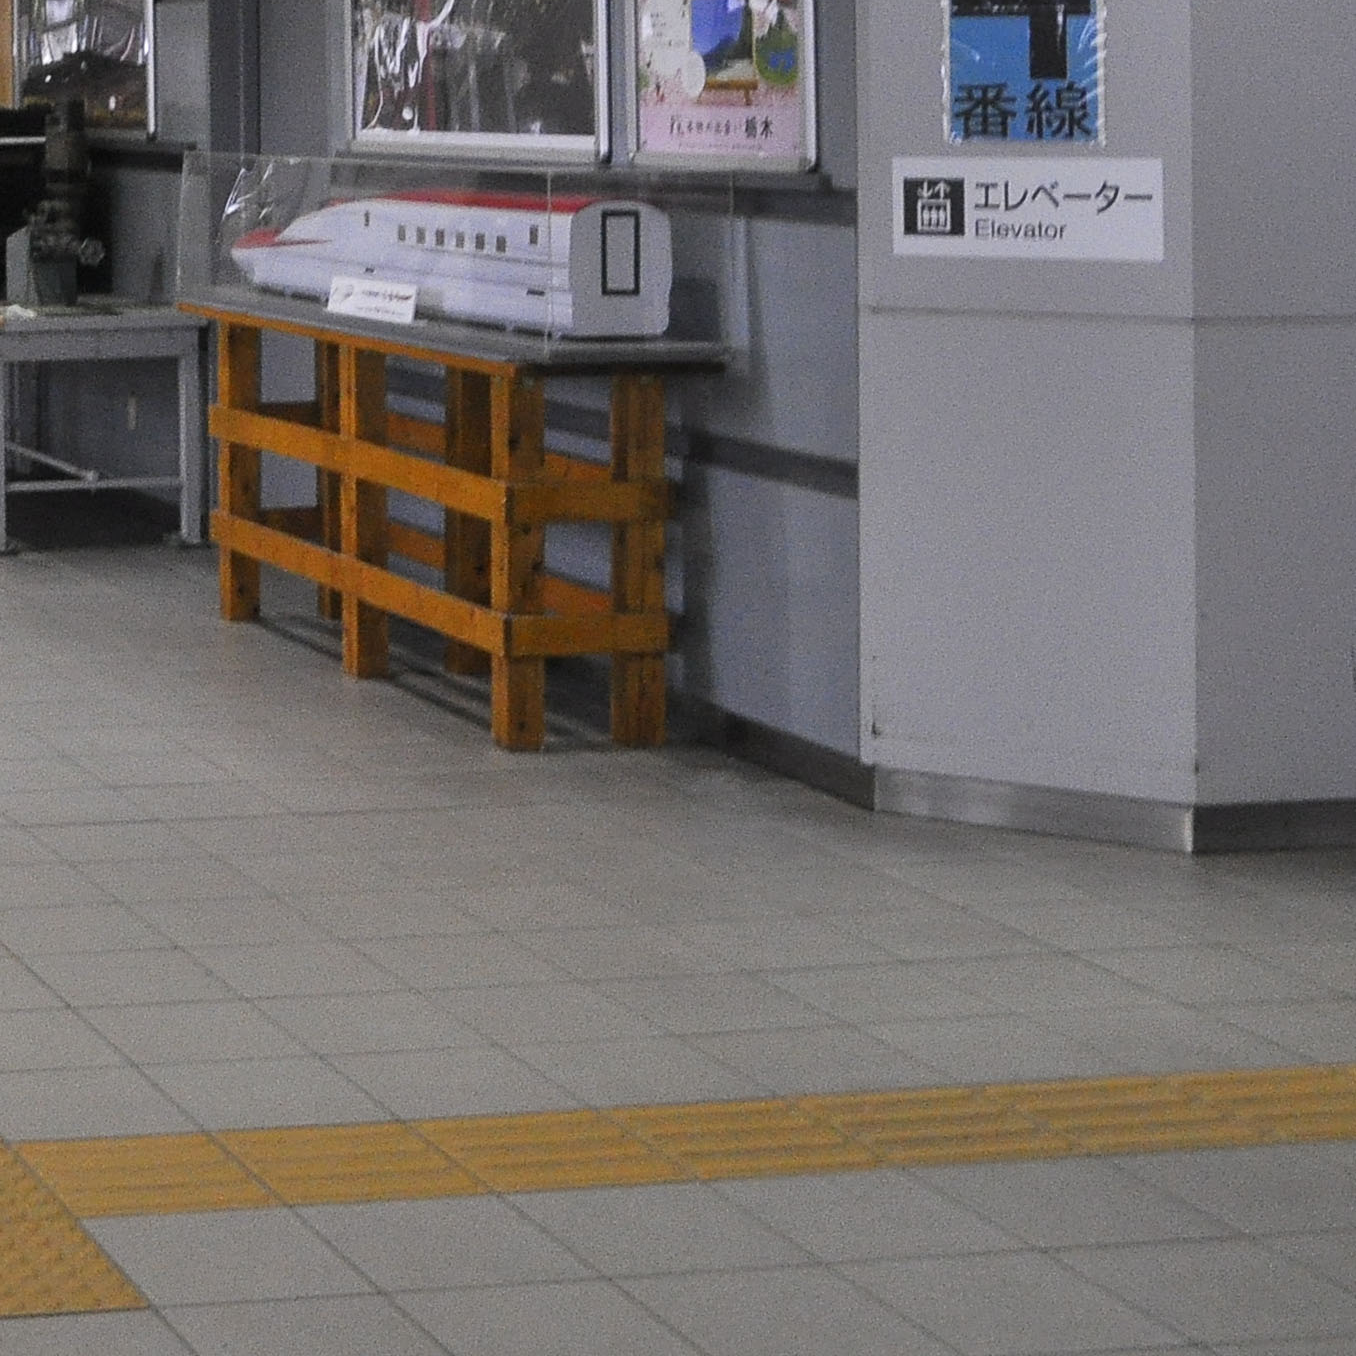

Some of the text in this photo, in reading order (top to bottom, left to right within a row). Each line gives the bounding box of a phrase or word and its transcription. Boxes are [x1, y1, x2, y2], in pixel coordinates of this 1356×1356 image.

[954, 81, 1092, 139] 番線
[974, 180, 1154, 216] エレベーター
[974, 218, 1067, 241] Elevator
